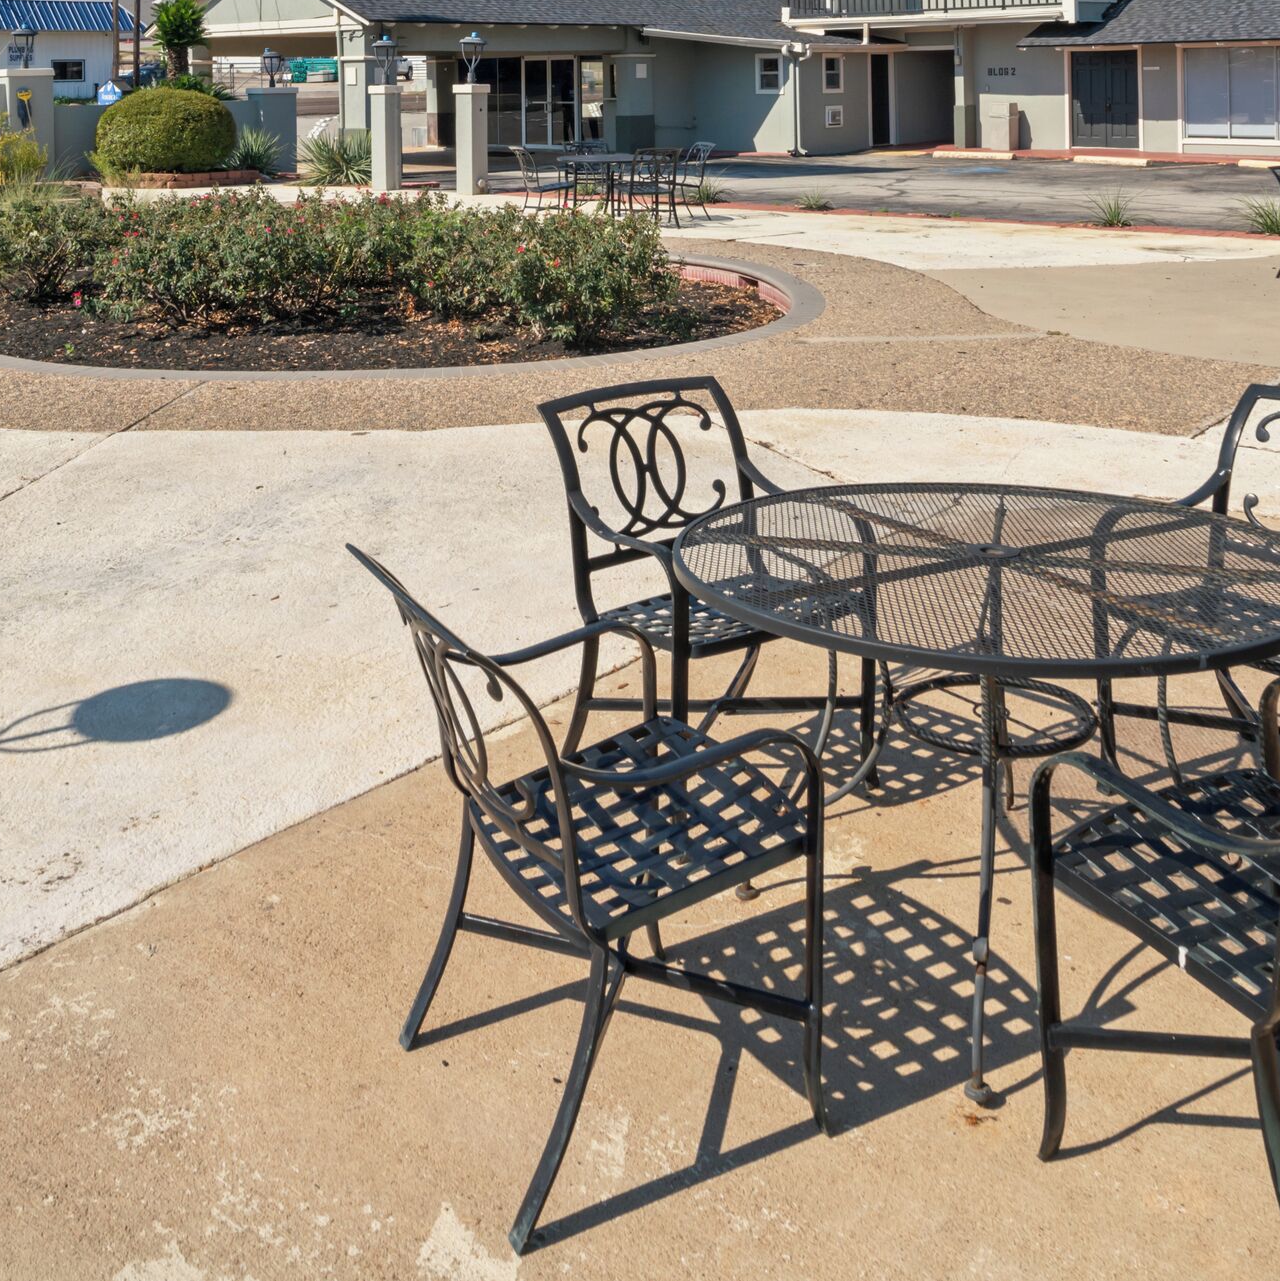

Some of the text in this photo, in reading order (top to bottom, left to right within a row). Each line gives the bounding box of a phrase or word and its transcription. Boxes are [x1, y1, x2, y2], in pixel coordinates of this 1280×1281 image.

[8, 46, 34, 54] PLUMBNG
[987, 67, 1016, 76] BLDG 2
